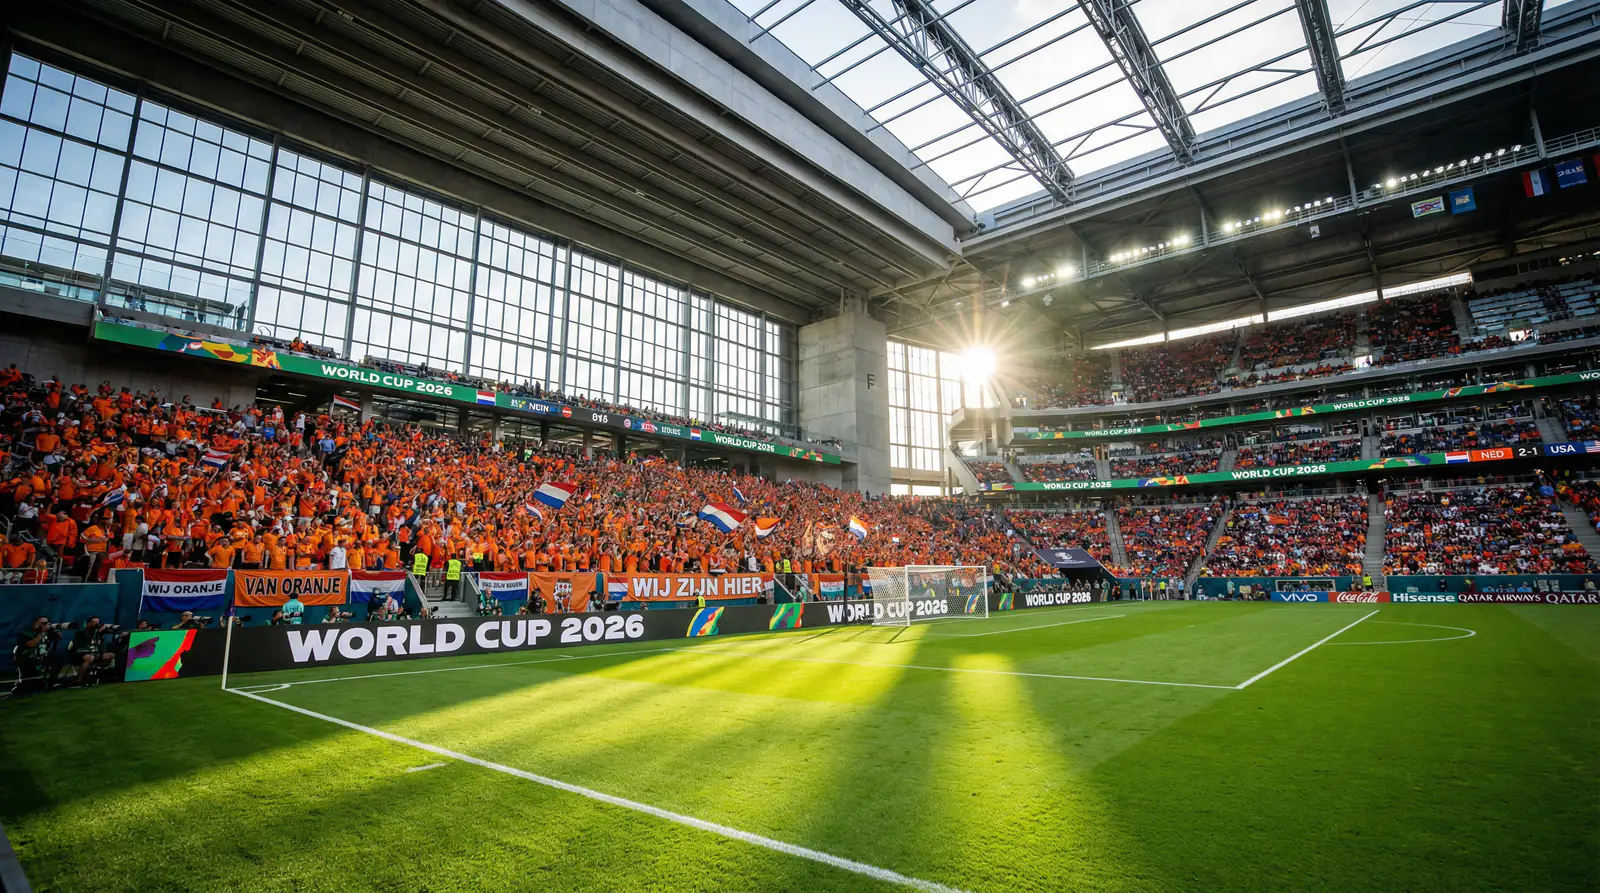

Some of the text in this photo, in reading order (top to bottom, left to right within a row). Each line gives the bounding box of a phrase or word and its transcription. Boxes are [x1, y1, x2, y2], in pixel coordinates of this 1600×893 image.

[321, 364, 453, 396] WORLD CUP 2026
[1333, 401, 1365, 410] WORLD
[1366, 398, 1385, 406] CUP
[714, 434, 775, 452] WORLD CUP 2026
[1550, 444, 1576, 454] USA
[1480, 450, 1505, 459] NED
[1518, 447, 1538, 457] 2-1
[1231, 464, 1327, 480] WORLD CUP 2026
[1043, 482, 1071, 490] WORLD
[148, 582, 223, 594] WIJ ORANJE
[244, 577, 341, 596] VAN ORANJE
[632, 576, 763, 598] WIJ ZIJN HIER
[1025, 591, 1092, 607] WORLD CUP 2026
[1392, 593, 1456, 603] Hisense
[1458, 593, 1541, 603] QATAR AIRWAYS
[1545, 593, 1599, 605] QATAR
[826, 601, 884, 623] WORLD
[915, 599, 948, 616] 2026
[286, 614, 645, 663] WORLD CUP 2026
